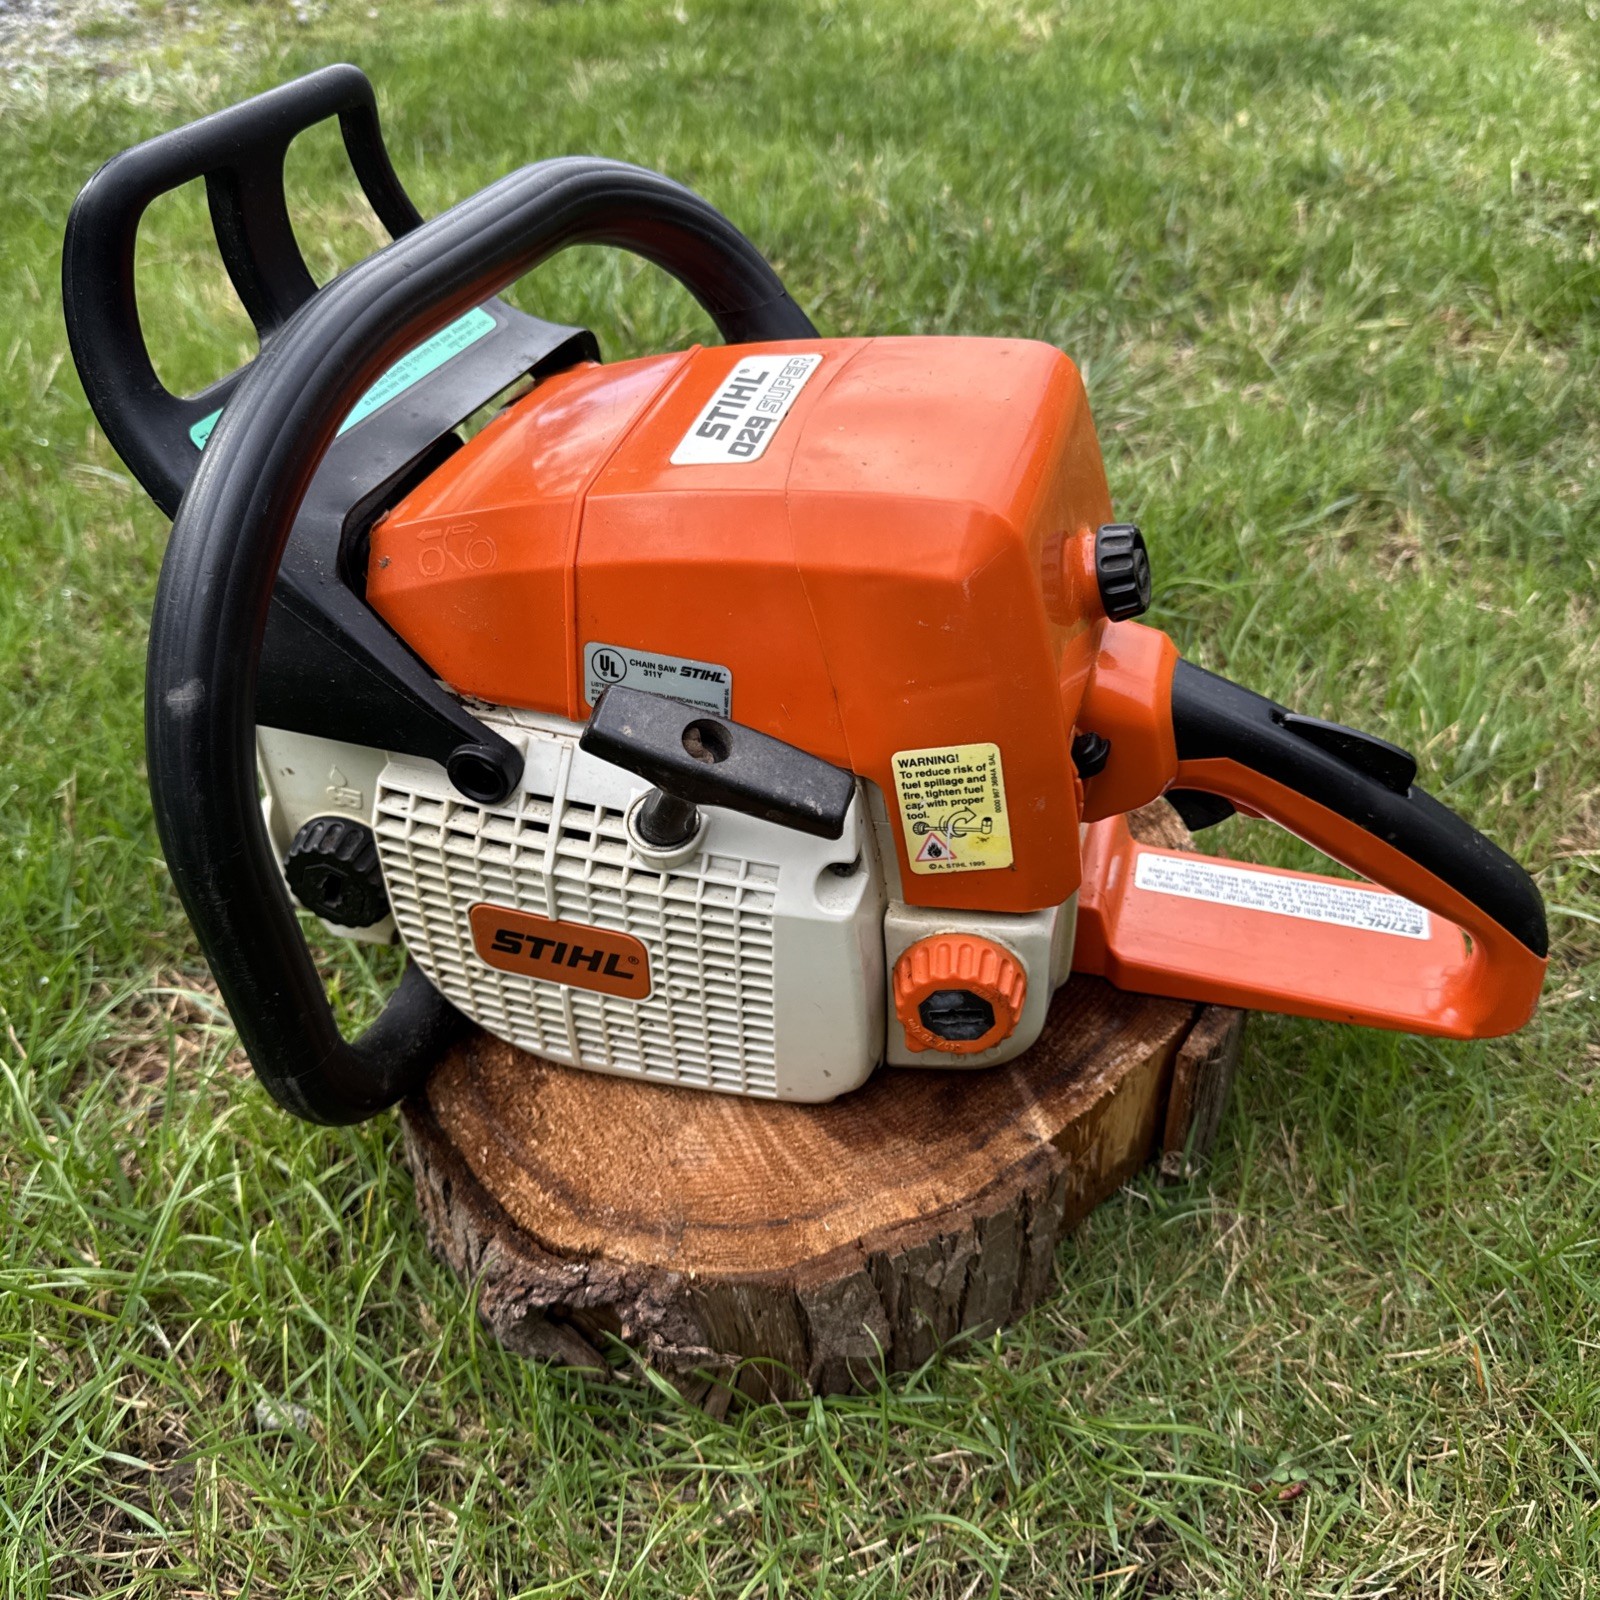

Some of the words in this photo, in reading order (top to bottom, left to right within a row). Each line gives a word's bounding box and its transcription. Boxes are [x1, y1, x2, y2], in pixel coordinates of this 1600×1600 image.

[728, 416, 773, 457] 029
[756, 358, 814, 413] SUPER
[600, 654, 619, 678] UL
[629, 659, 656, 670] CHAIN
[657, 663, 677, 673] SAW
[643, 670, 663, 678] 311Y
[694, 700, 719, 709] NATIONAL
[898, 754, 959, 768] WARNING!
[988, 754, 996, 766] SAL
[900, 771, 912, 779] To
[915, 768, 950, 777] reduce
[954, 765, 973, 774] risk
[976, 763, 986, 771] of
[901, 781, 921, 789] fuel
[924, 777, 964, 788] spillage
[967, 775, 986, 783] and
[903, 792, 924, 800] fire,
[925, 788, 961, 799] tighten
[964, 785, 984, 794] fuel
[905, 802, 924, 811] cap
[926, 799, 948, 808] with
[951, 797, 984, 807] proper
[907, 812, 930, 820] tool.
[1141, 877, 1191, 893] INFORMATION
[1194, 888, 1220, 898] ENGINE
[1223, 893, 1265, 907] IMPORTANT
